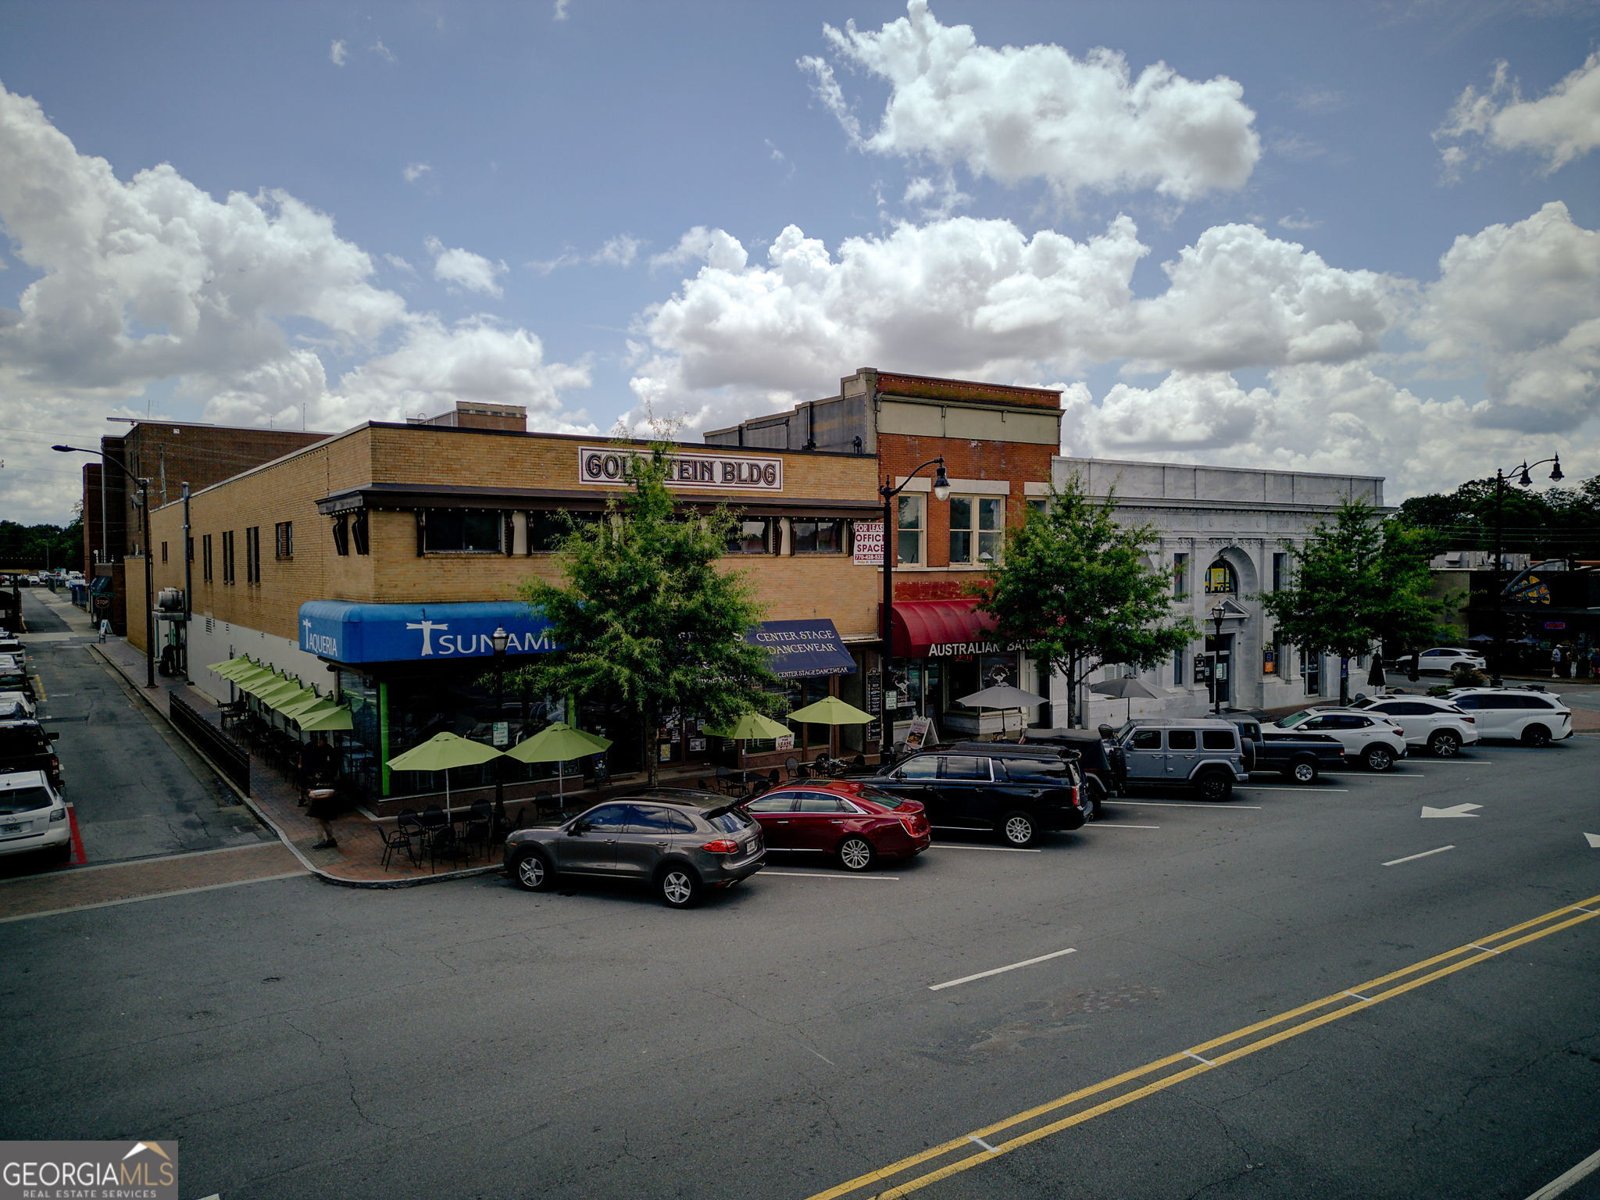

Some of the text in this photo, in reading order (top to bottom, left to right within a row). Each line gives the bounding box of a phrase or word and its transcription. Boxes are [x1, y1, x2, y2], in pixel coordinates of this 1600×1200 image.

[585, 453, 777, 486] GOLTEIN BLDG
[855, 524, 884, 532] FOR LEAS
[855, 534, 885, 542] OFFIC
[857, 544, 884, 552] SPACE
[302, 618, 338, 657] TAQUERIA
[756, 631, 799, 642] CENTER
[799, 630, 835, 640] STAGE
[767, 643, 837, 655] DANCEWEAR
[928, 641, 1000, 657] AUSTRALIAN
[777, 667, 848, 678] CENTER STAGE DANCEWEAR
